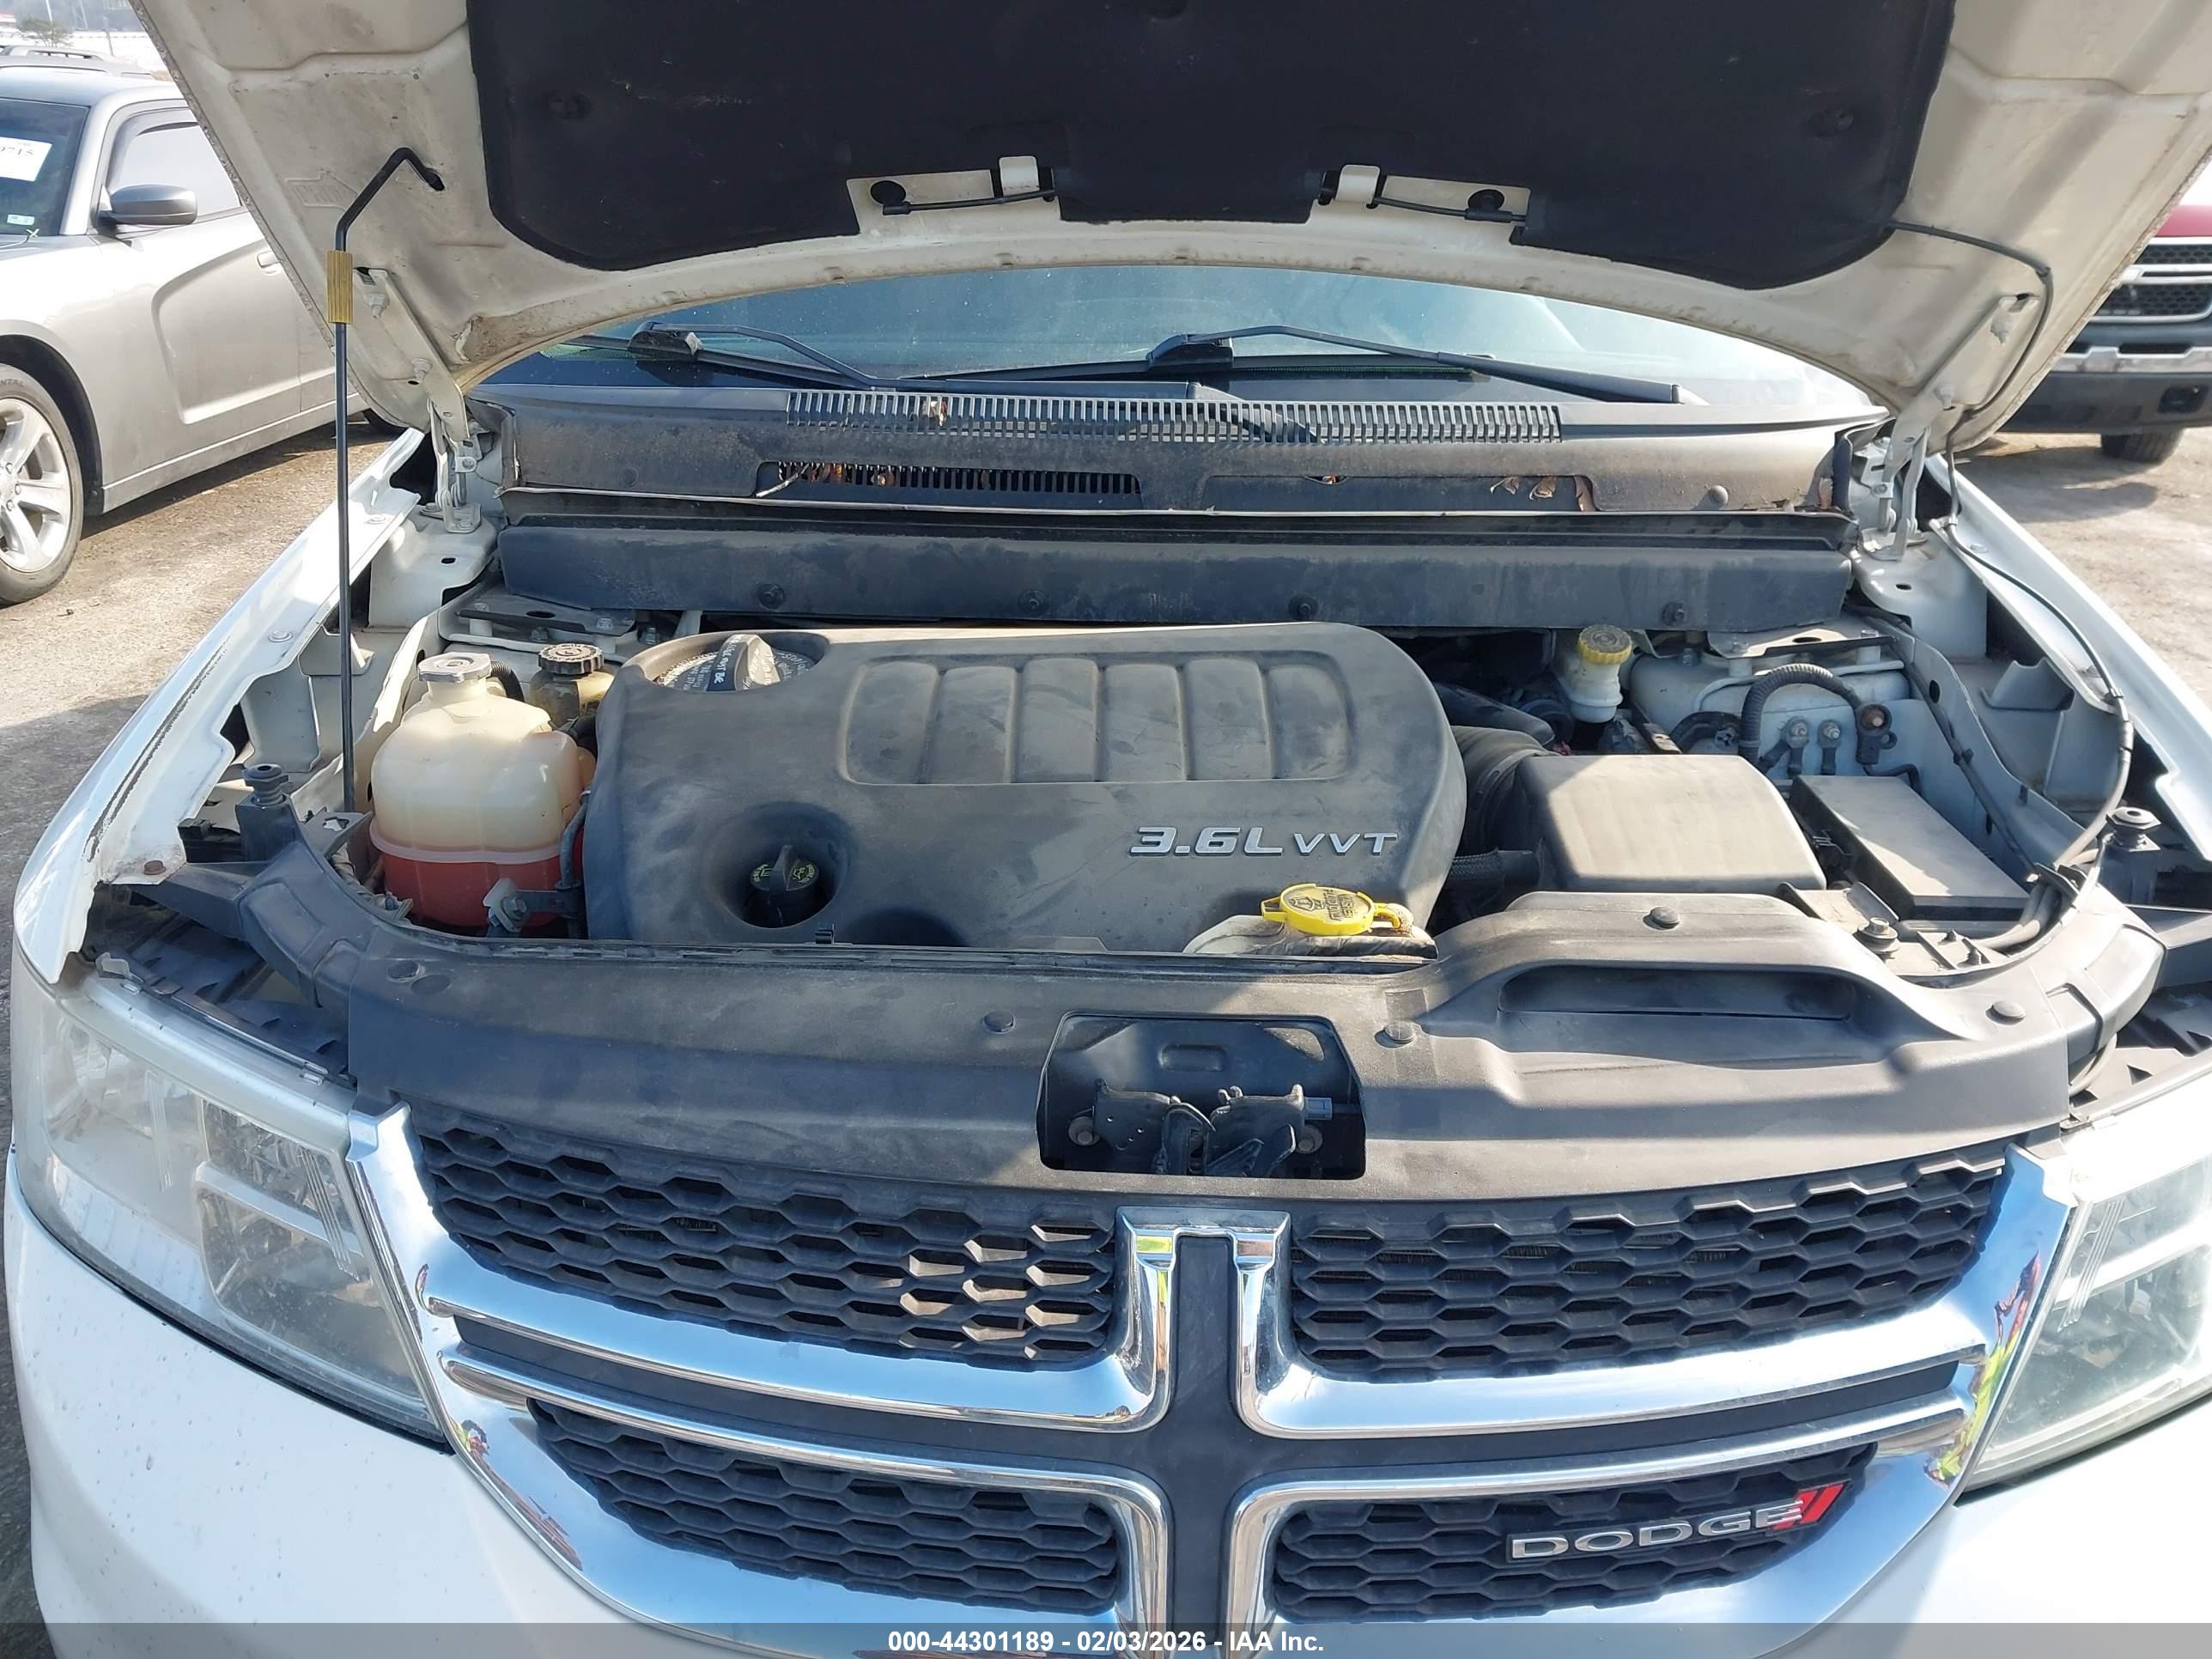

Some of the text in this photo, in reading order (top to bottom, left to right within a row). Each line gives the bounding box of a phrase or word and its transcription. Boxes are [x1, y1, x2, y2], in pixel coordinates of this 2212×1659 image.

[1129, 827, 1398, 856] 3.6L VVT
[1511, 1500, 1804, 1559] DODGE
